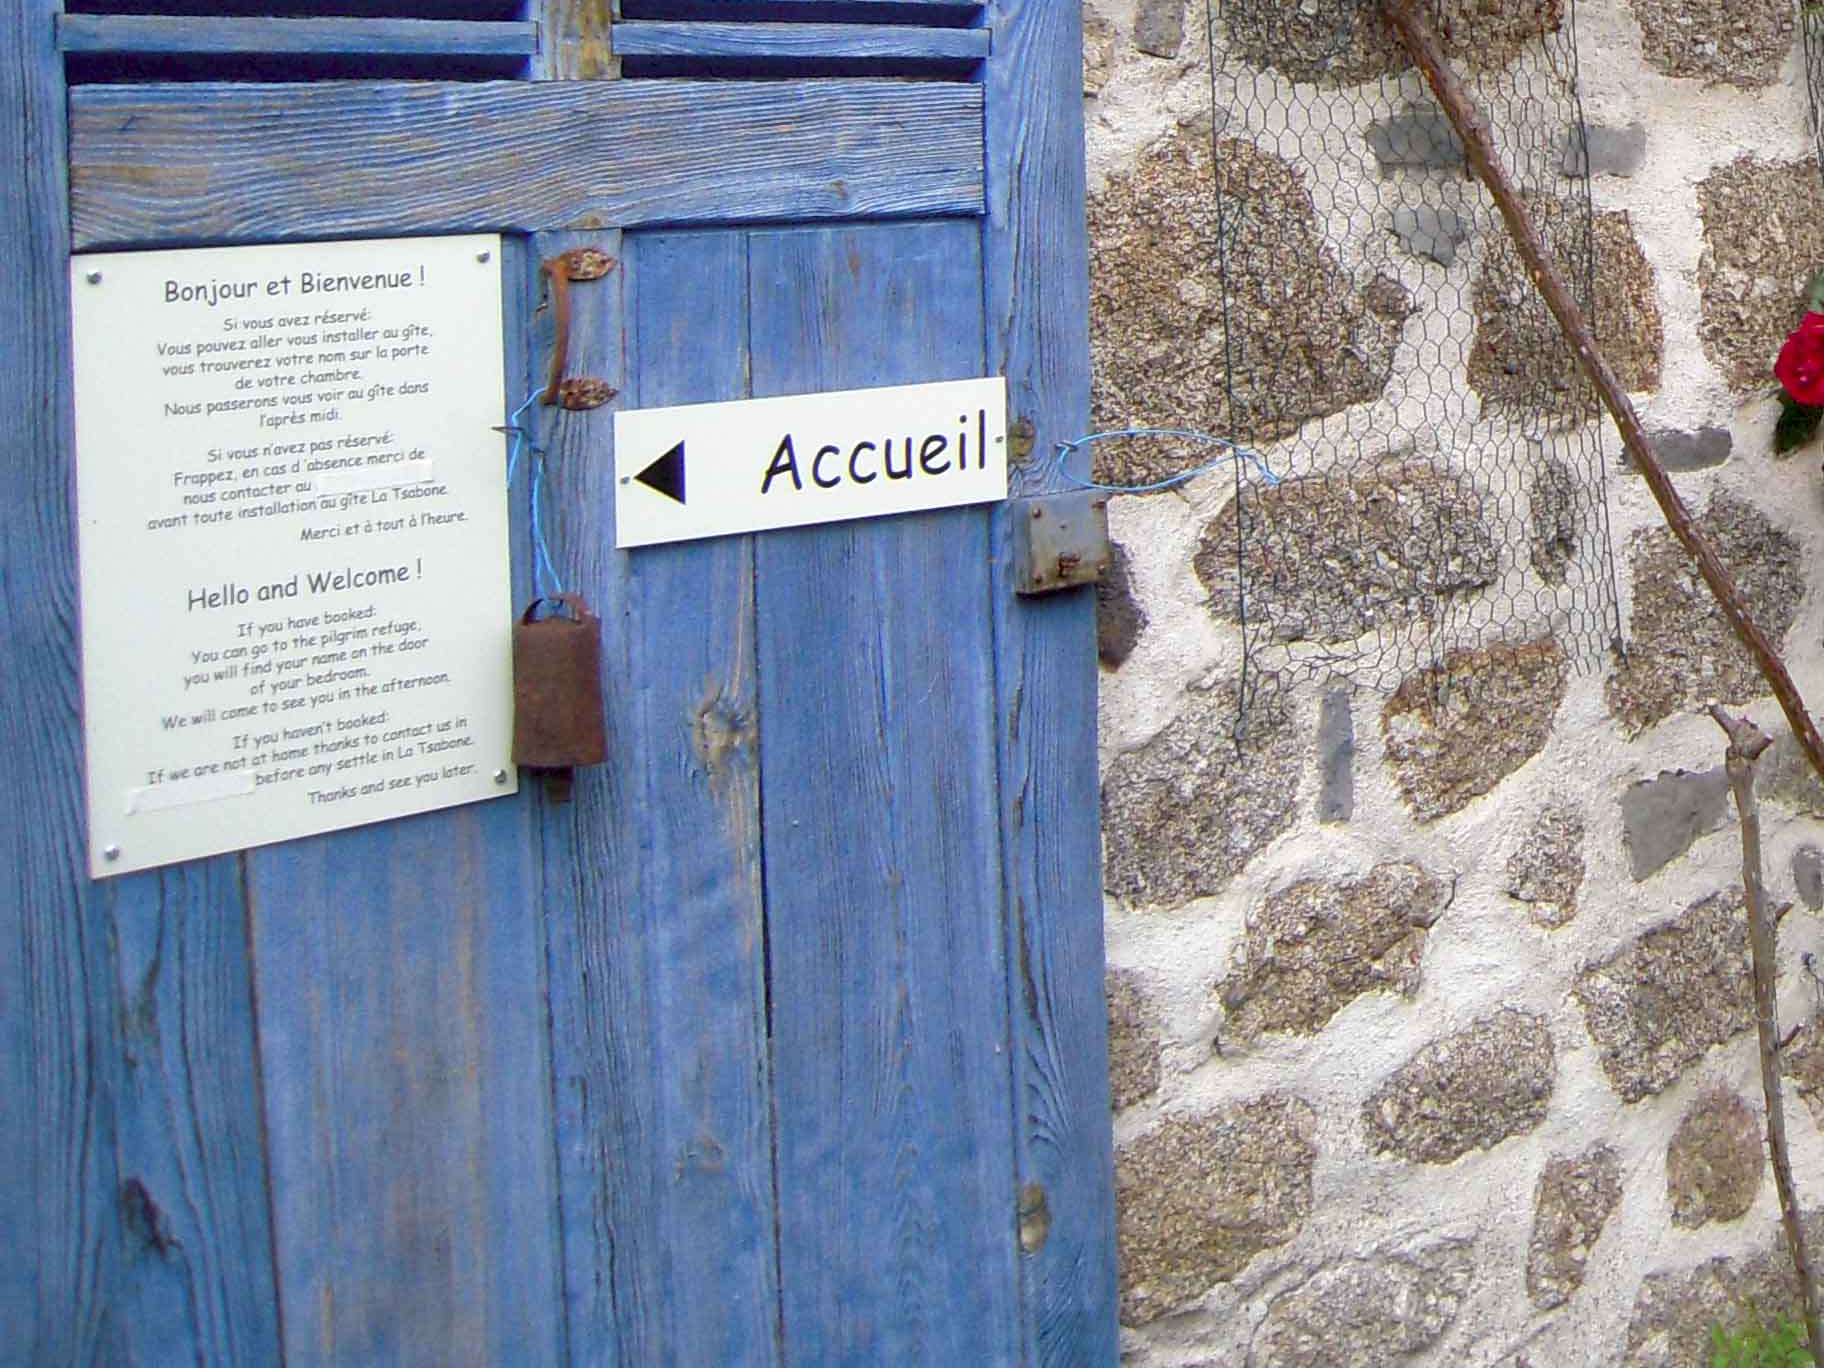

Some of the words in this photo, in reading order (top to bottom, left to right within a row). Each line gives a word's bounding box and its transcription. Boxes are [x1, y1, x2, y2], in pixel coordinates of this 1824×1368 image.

[165, 280, 257, 306] Bonjour
[267, 276, 291, 295] et
[301, 272, 412, 294] Bienvenue
[224, 318, 238, 331] Si
[243, 318, 274, 329] vous
[278, 316, 310, 327] avez
[158, 343, 191, 356] Vous
[196, 340, 246, 357] pouvez
[250, 334, 283, 349] aller
[287, 334, 317, 346] vous
[322, 328, 379, 343] installer
[383, 329, 399, 339] au
[163, 364, 195, 376] vous
[200, 358, 272, 373] trouverez
[275, 354, 313, 367] votre
[318, 352, 345, 363] nom
[350, 350, 372, 360] sur
[376, 346, 388, 358] la
[392, 344, 429, 360] porte
[165, 403, 202, 416] Nous
[206, 396, 278, 416] passerons
[282, 393, 312, 405] vous
[317, 388, 345, 402] voir
[348, 389, 363, 399] au
[367, 384, 394, 401] gîte
[398, 382, 429, 395] dans
[235, 376, 254, 390] de
[257, 376, 296, 387] votre
[208, 449, 222, 463] Si
[227, 448, 258, 460] vous
[263, 443, 306, 456] n'avez
[310, 440, 333, 455] pas
[242, 468, 259, 478] en
[263, 464, 286, 476] cas
[367, 452, 404, 464] merci
[408, 448, 424, 460] de
[760, 408, 986, 494] Accueil
[148, 514, 188, 530] avant
[194, 510, 233, 524] toute
[238, 496, 318, 518] installation
[320, 499, 336, 509] au
[340, 490, 369, 511] gîte
[371, 487, 389, 503] La
[184, 492, 216, 504] nous
[220, 484, 292, 501] contacter
[295, 482, 311, 493] au
[300, 524, 340, 541] Merci
[345, 523, 360, 536] et
[364, 520, 373, 533] à
[377, 518, 404, 532] tout
[409, 514, 417, 528] à
[188, 584, 249, 611] Hello
[257, 575, 298, 601] and
[307, 567, 410, 594] Welcome
[238, 622, 254, 637] If
[258, 622, 283, 638] you
[287, 616, 320, 629] have
[324, 605, 376, 624] booked:
[192, 651, 219, 664] You
[222, 647, 248, 659] can
[251, 644, 269, 659] go
[273, 640, 288, 652] to
[292, 635, 317, 648] the
[321, 627, 369, 648] pilgrim
[184, 673, 210, 690] you
[214, 665, 237, 681] will
[242, 659, 273, 677] find
[276, 657, 308, 675] your
[312, 651, 347, 666] name
[352, 648, 367, 659] on
[371, 641, 394, 656] the
[399, 638, 429, 651] door
[250, 680, 266, 696] of
[270, 678, 303, 695] your
[162, 715, 187, 730] We
[191, 709, 216, 725] will
[221, 705, 258, 720] come
[262, 702, 278, 713] to
[282, 697, 306, 710] see
[310, 692, 334, 709] you
[338, 688, 352, 700] in
[355, 683, 378, 696] the
[232, 734, 248, 749] If
[253, 733, 279, 750] you
[283, 721, 333, 741] haven't
[337, 710, 390, 731] booked:
[148, 769, 164, 784] If
[169, 769, 190, 780] we
[194, 764, 219, 776] are
[223, 757, 248, 770] not
[251, 753, 267, 768] at
[272, 747, 310, 762] home
[314, 736, 360, 755] thanks
[364, 734, 379, 746] to
[382, 723, 432, 742] contact
[436, 721, 452, 732] us
[454, 717, 467, 728] in
[256, 768, 306, 786] before
[309, 762, 332, 776] any
[337, 752, 379, 770] settle
[382, 749, 394, 762] in
[398, 746, 413, 759] La
[308, 784, 358, 804] Thanks
[361, 779, 385, 795] and
[389, 777, 412, 790] see
[415, 772, 439, 788] you
[442, 764, 477, 778] later.
